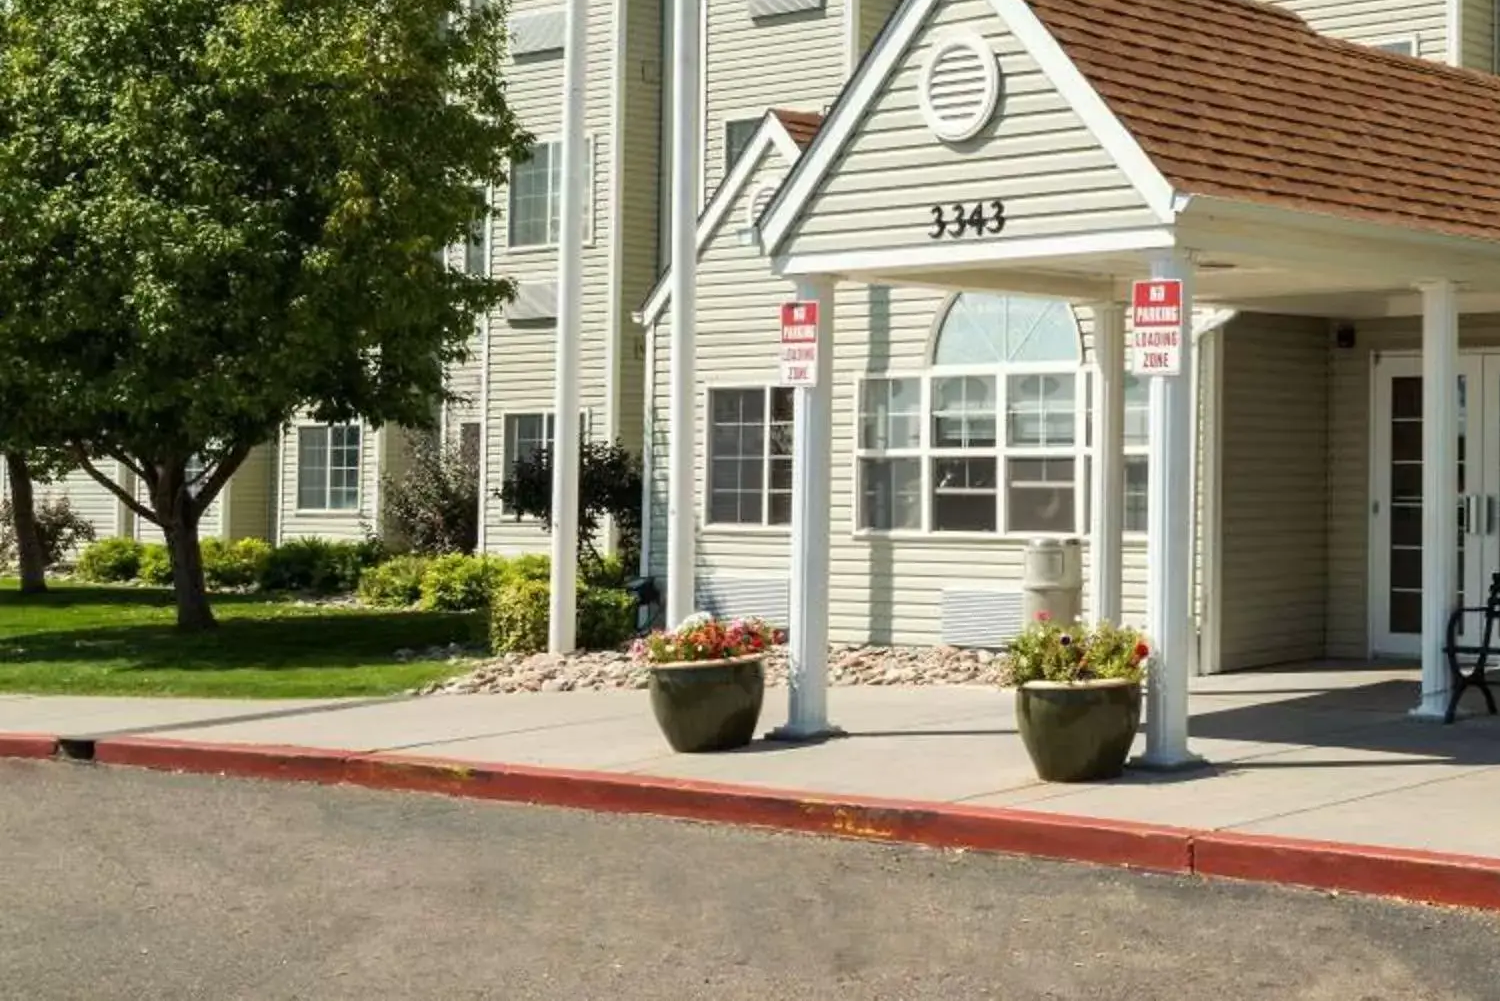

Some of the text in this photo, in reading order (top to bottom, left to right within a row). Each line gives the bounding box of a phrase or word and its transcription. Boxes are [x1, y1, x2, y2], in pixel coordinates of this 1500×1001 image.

[927, 201, 1005, 238] 3343
[1149, 285, 1165, 302] NO
[1135, 305, 1178, 323] PARKING
[783, 325, 815, 340] PARKING
[1135, 331, 1178, 347] LOADING
[1143, 352, 1169, 368] ZONE
